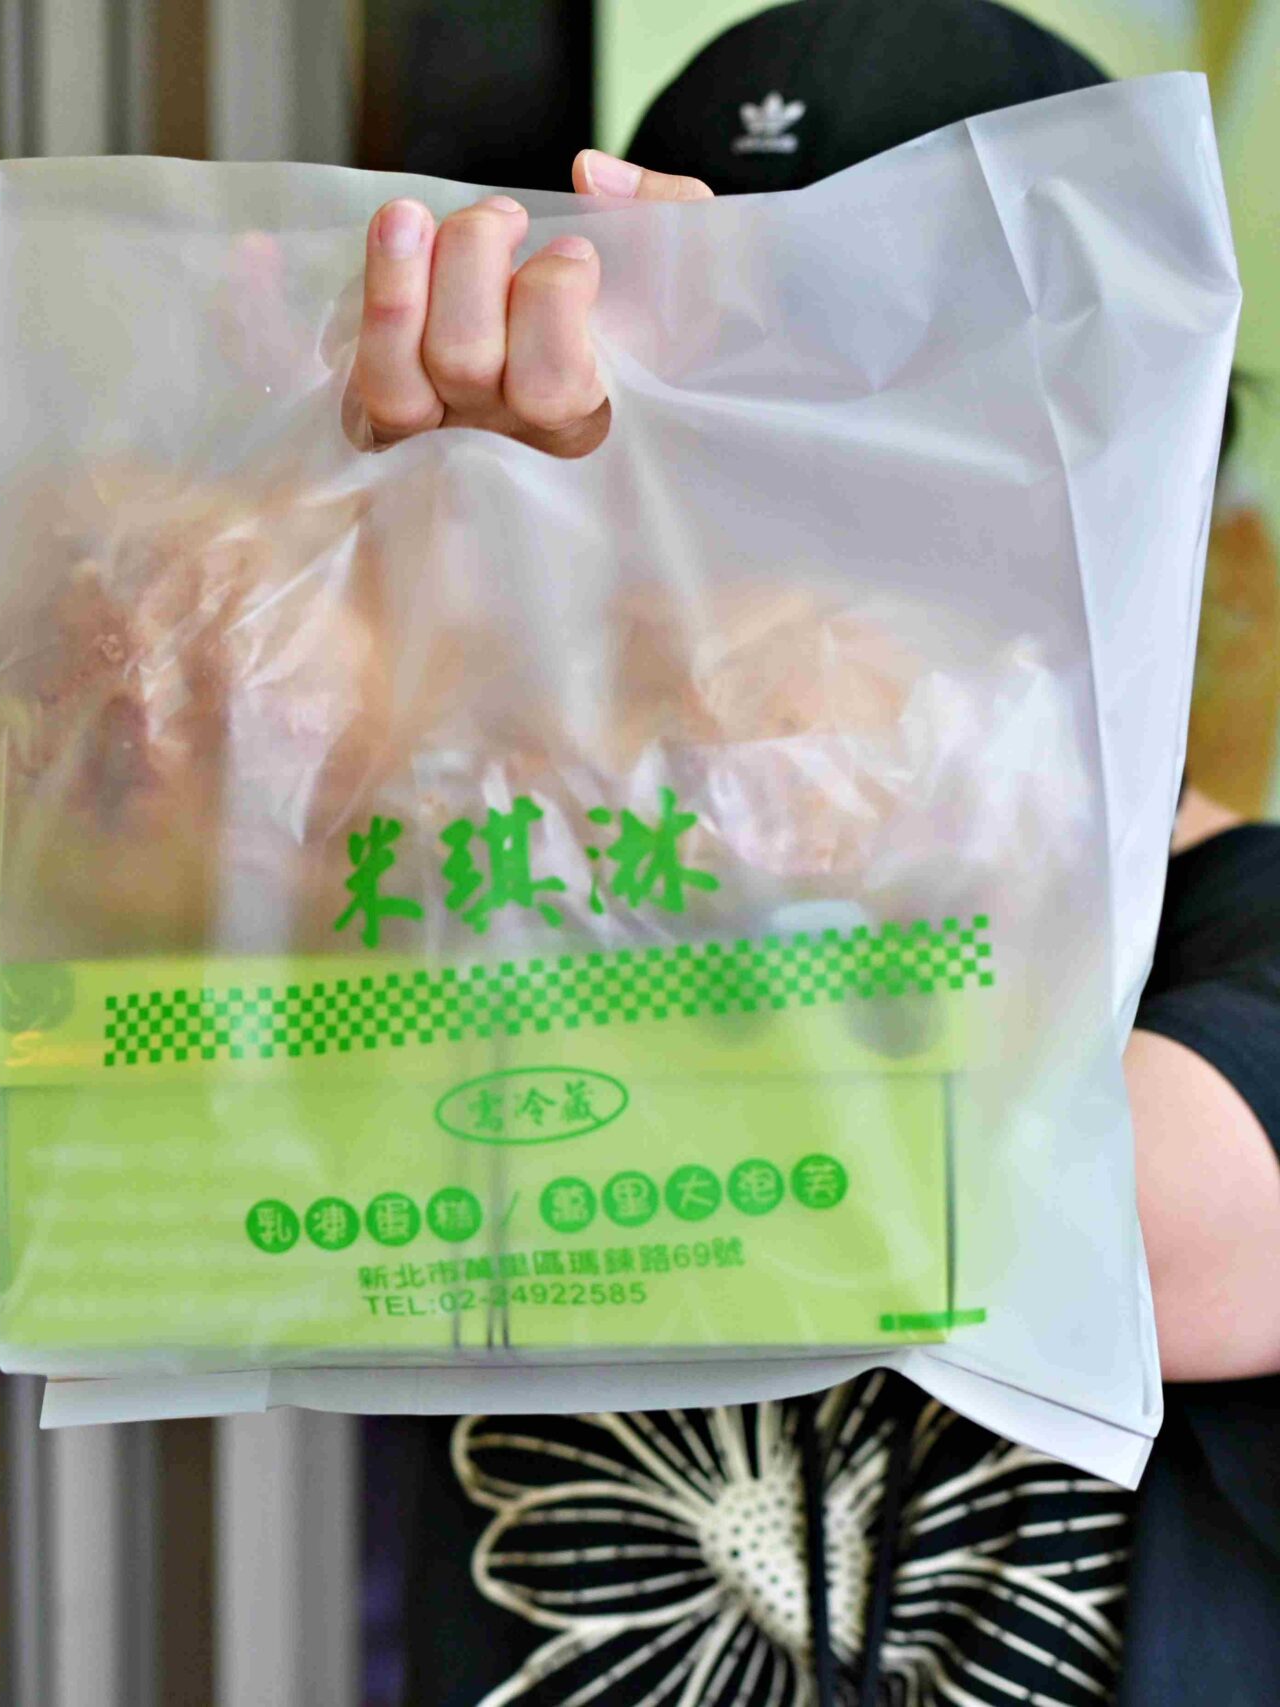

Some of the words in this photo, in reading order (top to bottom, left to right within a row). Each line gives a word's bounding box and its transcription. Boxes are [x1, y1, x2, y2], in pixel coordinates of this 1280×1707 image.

[467, 1080, 605, 1131] 需冷藏
[255, 1194, 476, 1245] 乳凍蛋糕
[549, 1163, 840, 1227] 萬里大泡芙
[364, 1282, 648, 1318] TEL:02-24922585
